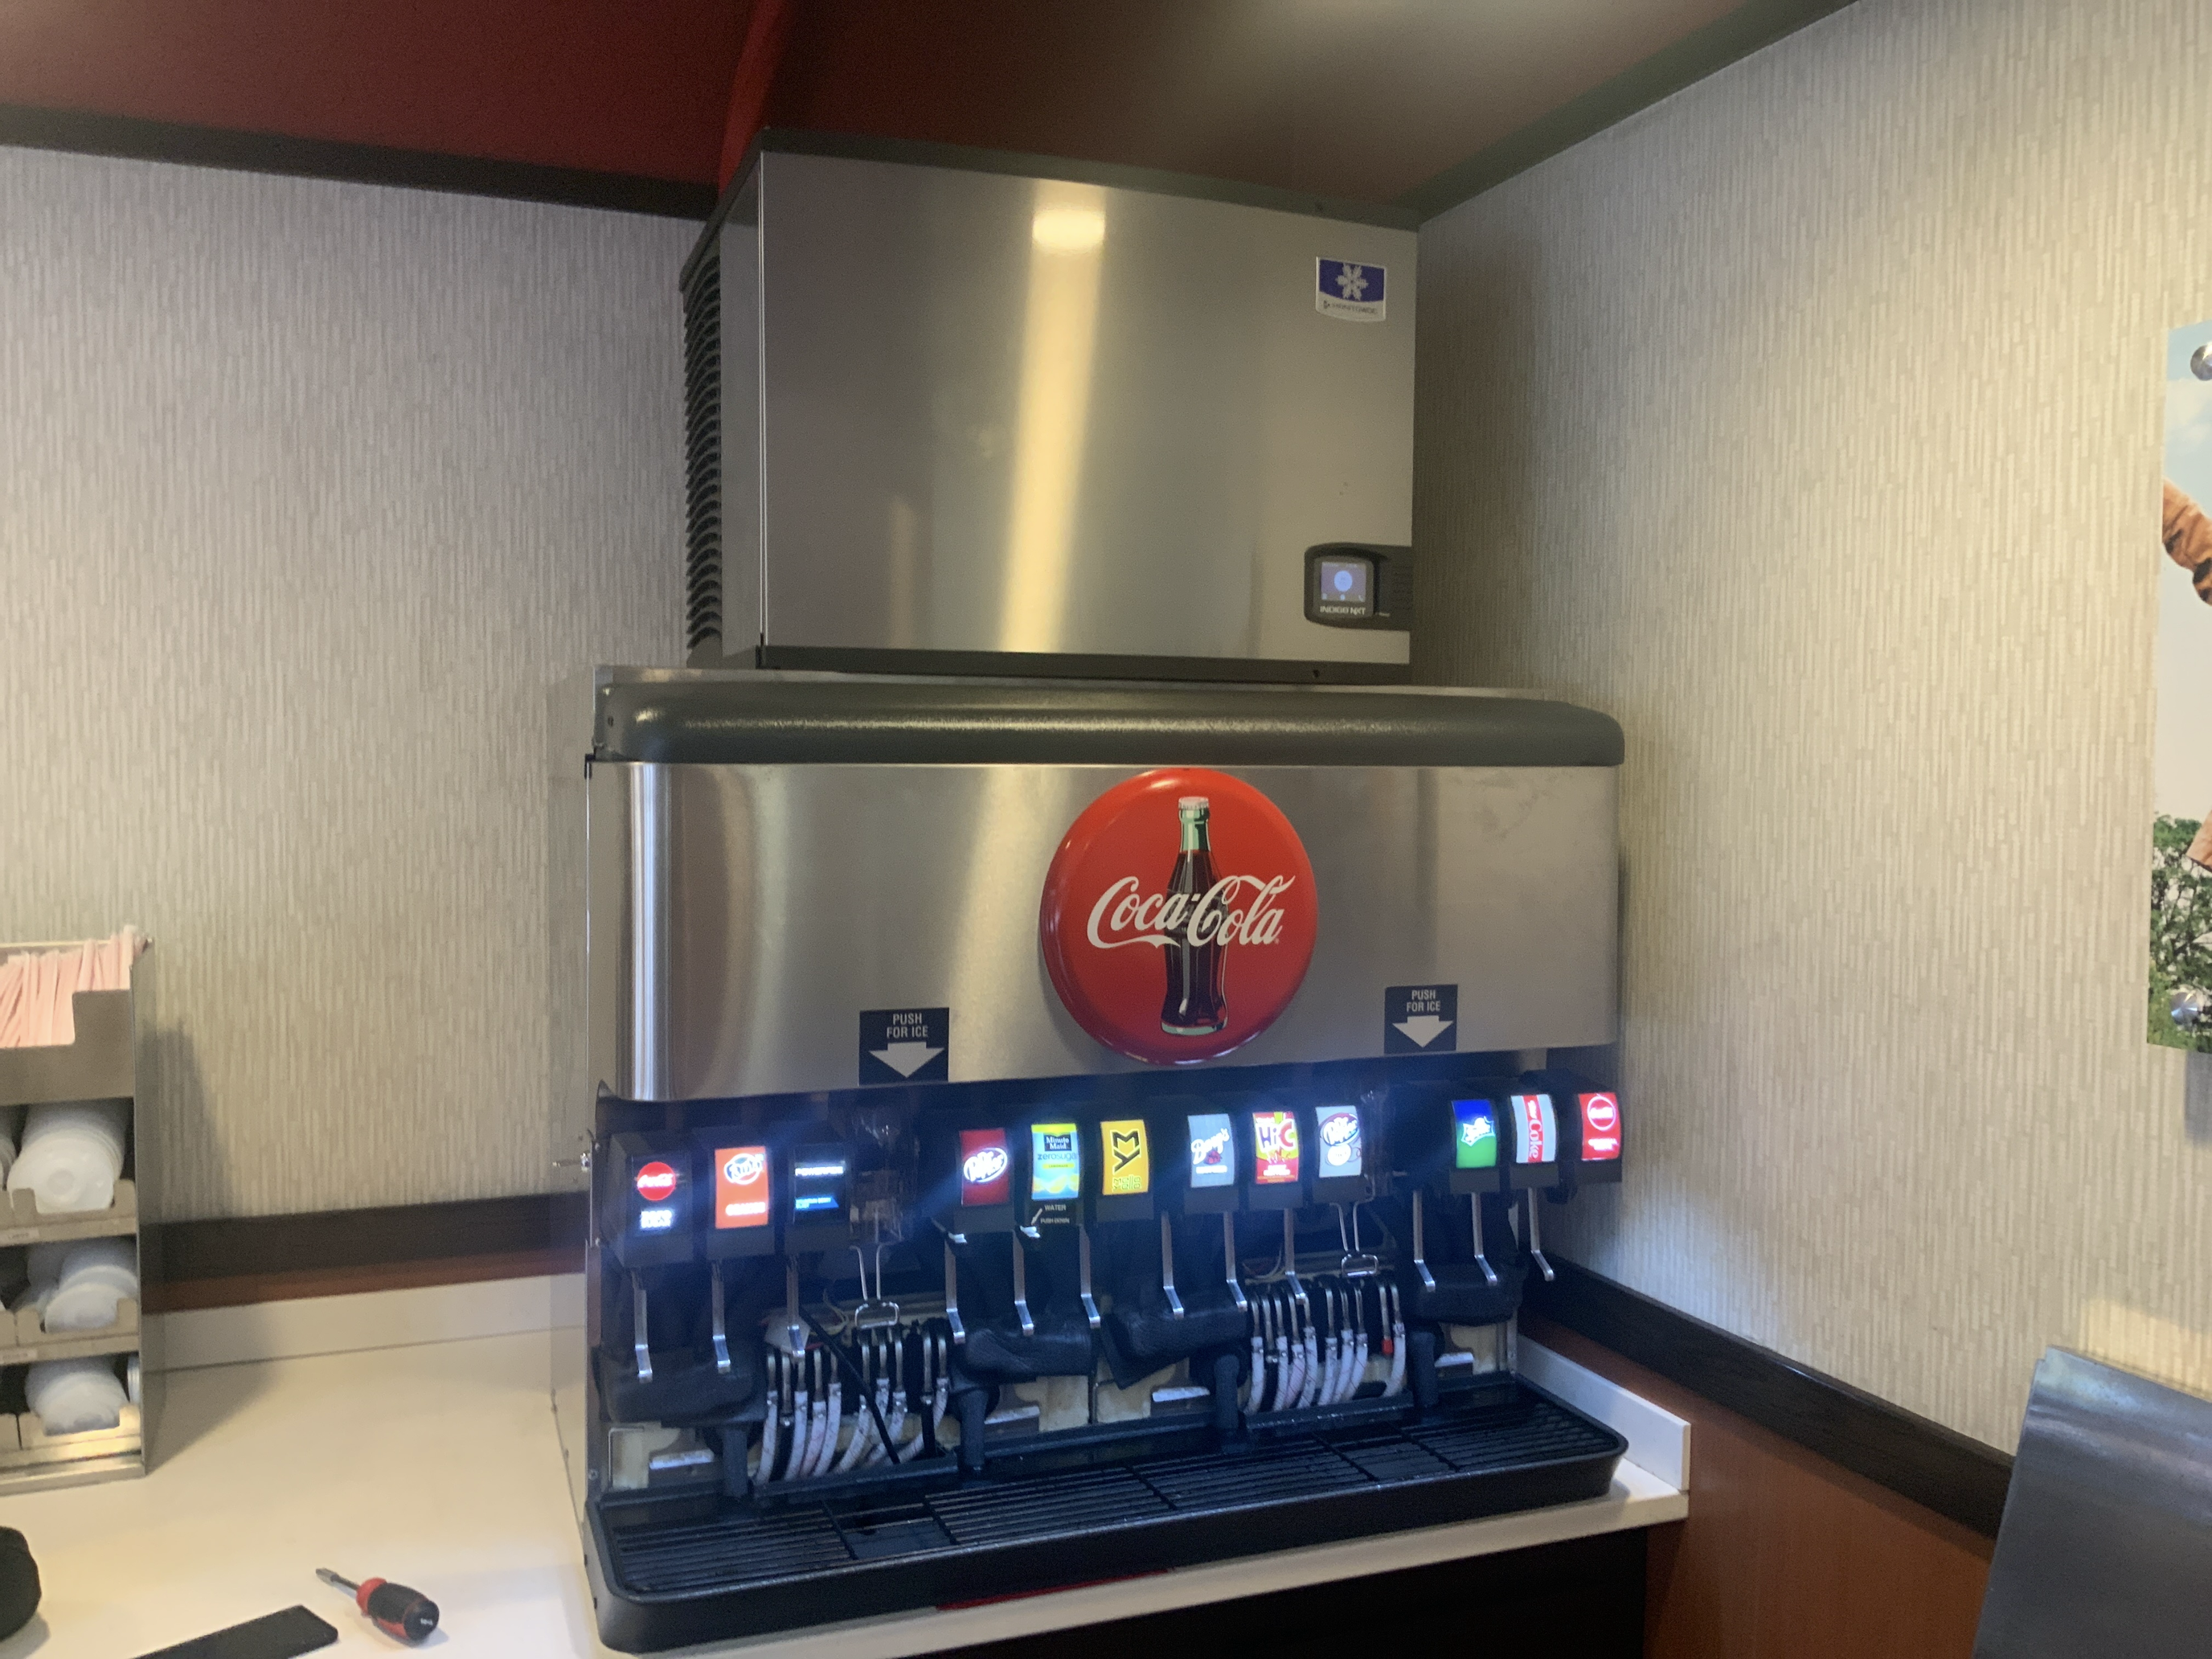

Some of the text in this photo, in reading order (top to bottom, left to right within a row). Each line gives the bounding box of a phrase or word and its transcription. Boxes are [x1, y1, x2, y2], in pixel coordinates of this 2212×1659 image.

[1320, 605, 1349, 614] INDIGO
[1350, 606, 1366, 615] NXT
[1087, 875, 1296, 949] Coca-Cola
[1411, 989, 1436, 1000] PUSH
[1407, 1001, 1440, 1012] FOR ICE
[893, 1013, 922, 1025] PUSH
[887, 1025, 928, 1038] FOR ICE
[1530, 1120, 1542, 1159] Coke
[1037, 1153, 1077, 1161] zerosuga
